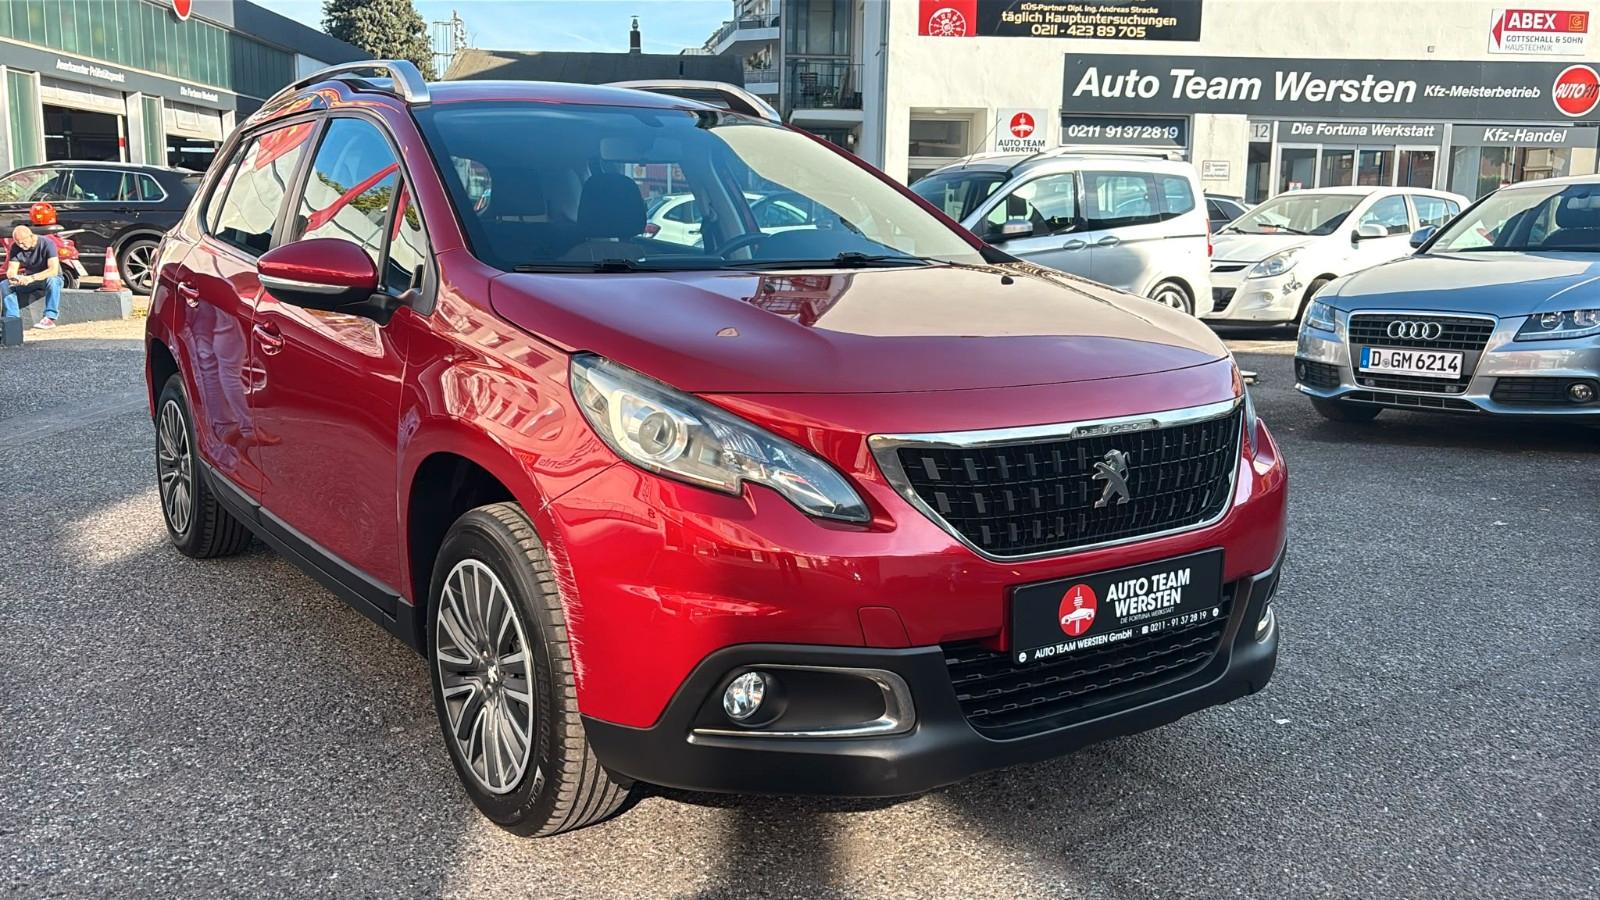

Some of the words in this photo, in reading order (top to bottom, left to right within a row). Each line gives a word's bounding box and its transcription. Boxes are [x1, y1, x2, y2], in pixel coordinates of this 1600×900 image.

[1131, 6, 1158, 14] Stracke
[1002, 11, 1042, 24] täglich
[1045, 12, 1177, 27] Hauptuntersuchungen
[1508, 12, 1557, 30] ABEX
[1031, 24, 1058, 35] 0211
[1067, 25, 1094, 36] 423
[1097, 26, 1116, 36] 89
[1119, 26, 1146, 37] 705
[1506, 35, 1554, 44] GOTTSCHALL
[1562, 36, 1584, 44] SOHN
[1505, 43, 1553, 52] HAUSTECHNIK
[1072, 67, 1160, 98] Auto
[1170, 69, 1262, 100] Team
[1275, 71, 1417, 103] Wersten
[1424, 84, 1541, 99] Kfz-Meisterbetrieb
[1068, 124, 1100, 138] 0211
[1105, 124, 1178, 139] 91372819
[1254, 124, 1269, 138] 12
[1291, 122, 1313, 135] Die
[1316, 123, 1367, 136] Fortuna
[1371, 124, 1436, 137] Werkstatt
[1483, 129, 1568, 143] Kfz-Handel
[998, 139, 1021, 147] AUTO
[1023, 139, 1046, 147] TEAM
[1371, 351, 1381, 366] D
[1391, 352, 1412, 369] GM
[1416, 353, 1458, 373] 6214
[1106, 577, 1149, 602] AUTO
[1151, 568, 1191, 592] TEAM
[1115, 587, 1181, 617] WERSTEN
[1034, 645, 1055, 660] AUTO
[1056, 641, 1077, 655] TEAM
[1077, 634, 1108, 649] WERSTEN
[1109, 629, 1133, 642] GmbH
[1150, 621, 1166, 632] 0211
[1171, 617, 1179, 627] 91
[1180, 615, 1189, 625] 37
[1190, 612, 1198, 623] 28
[1199, 610, 1207, 620] 19
